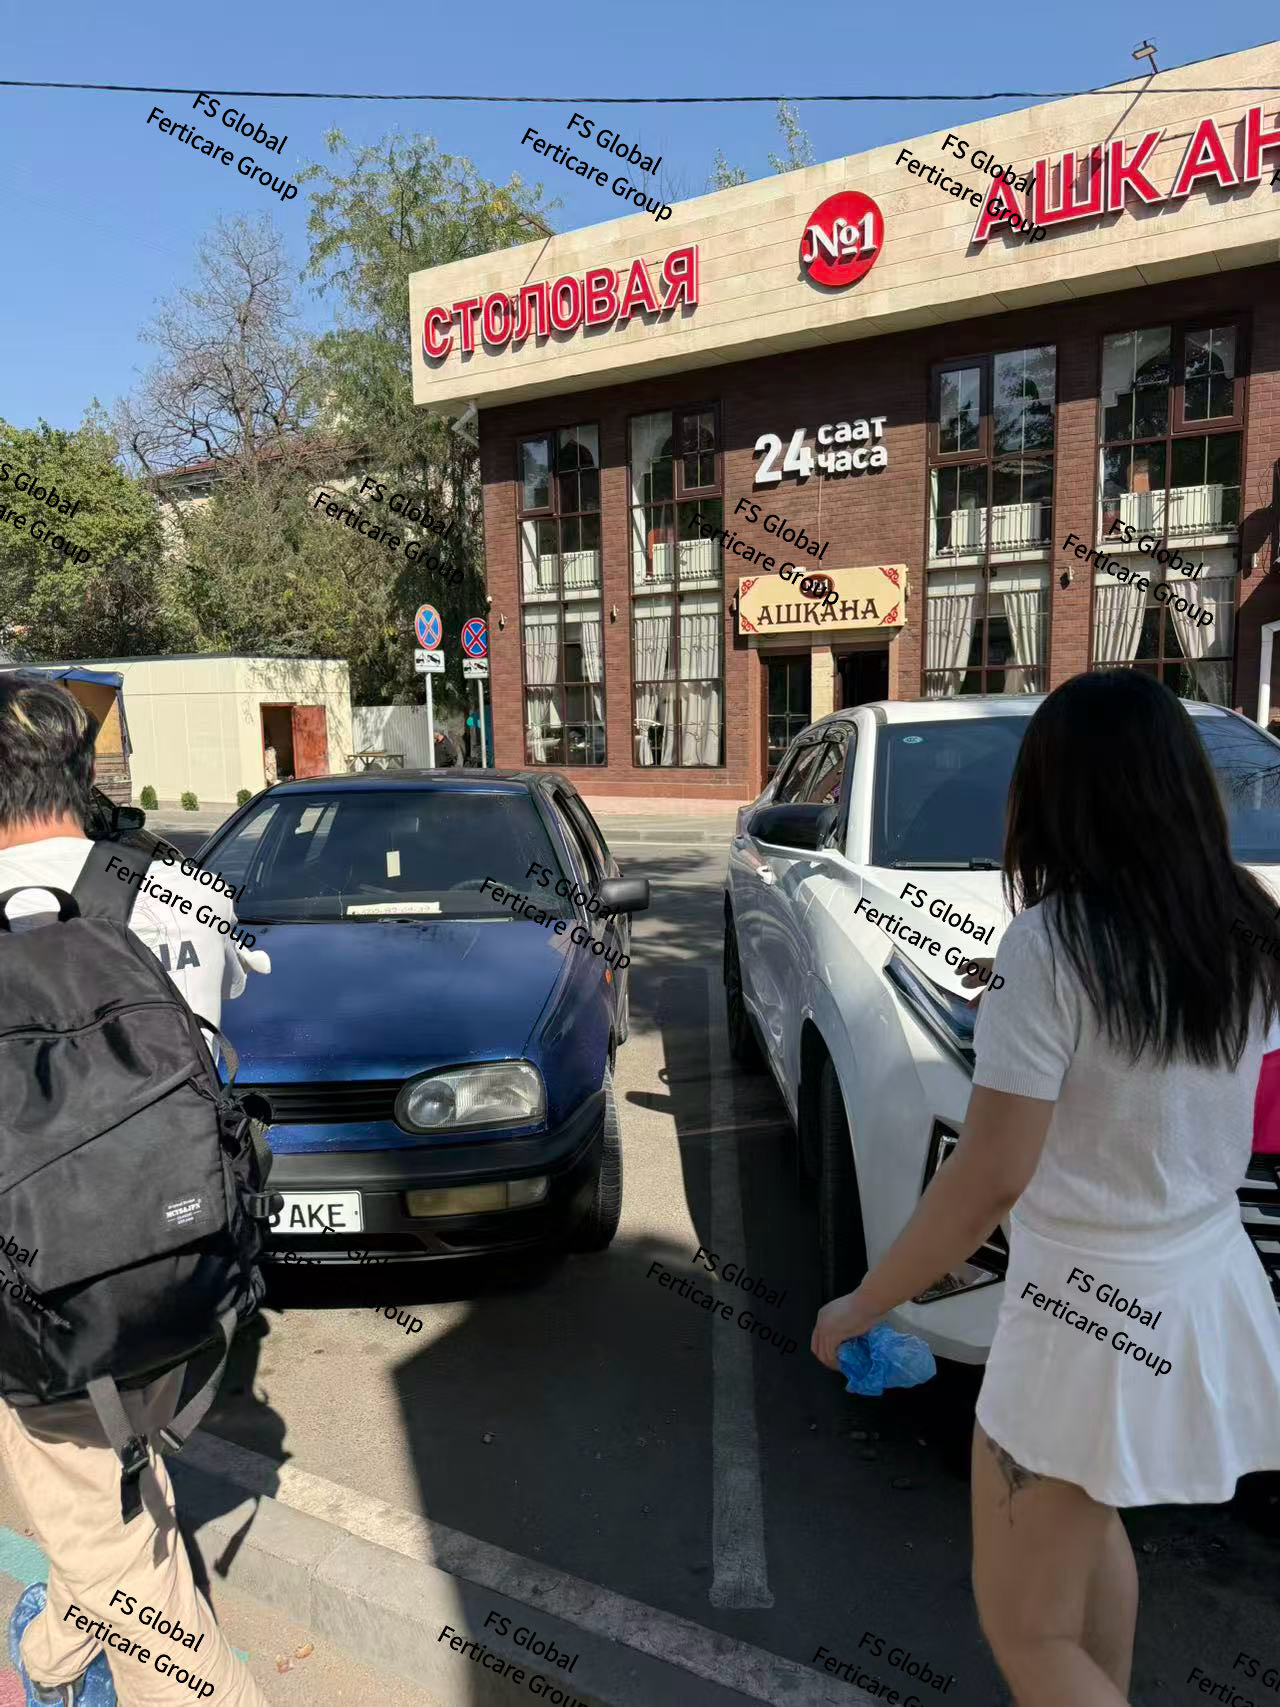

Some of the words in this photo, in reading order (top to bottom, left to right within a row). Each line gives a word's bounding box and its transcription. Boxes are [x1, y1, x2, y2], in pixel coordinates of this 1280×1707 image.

[423, 244, 698, 358] СТОЛОВАЯ
[754, 428, 814, 483] 24
[817, 416, 887, 445] саат
[817, 446, 888, 473] часа
[757, 598, 880, 626] АШКАНА
[289, 1204, 346, 1228] AKE
